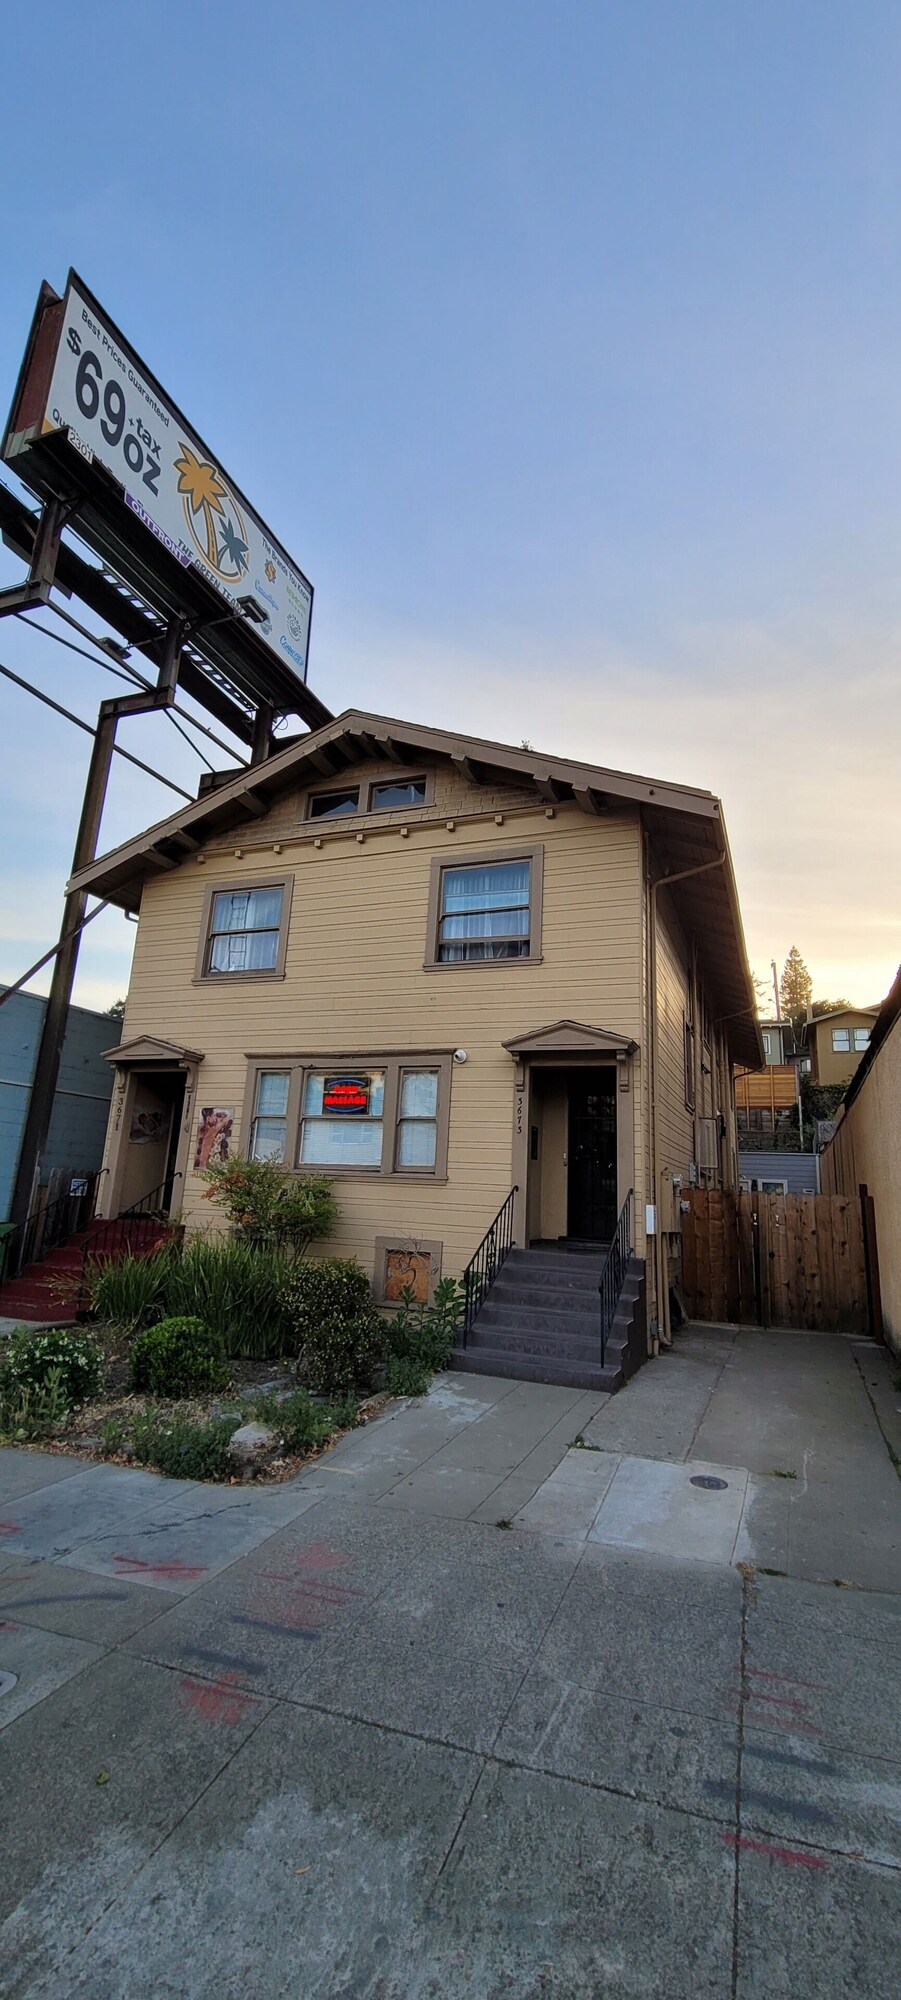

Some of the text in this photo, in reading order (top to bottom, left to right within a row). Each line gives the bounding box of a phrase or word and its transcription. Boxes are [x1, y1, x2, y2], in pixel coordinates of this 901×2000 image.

[81, 309, 170, 428] Best Prices Guaranteed
[69, 432, 92, 461] 2301
[123, 433, 161, 498] oz
[131, 500, 185, 561] OUTFRONT
[178, 538, 194, 559] THE
[194, 559, 220, 590] GREEN
[262, 537, 271, 554] The
[272, 550, 288, 576] Brands
[289, 571, 297, 588] You
[297, 583, 309, 602] Know
[115, 1097, 124, 1131] 3671
